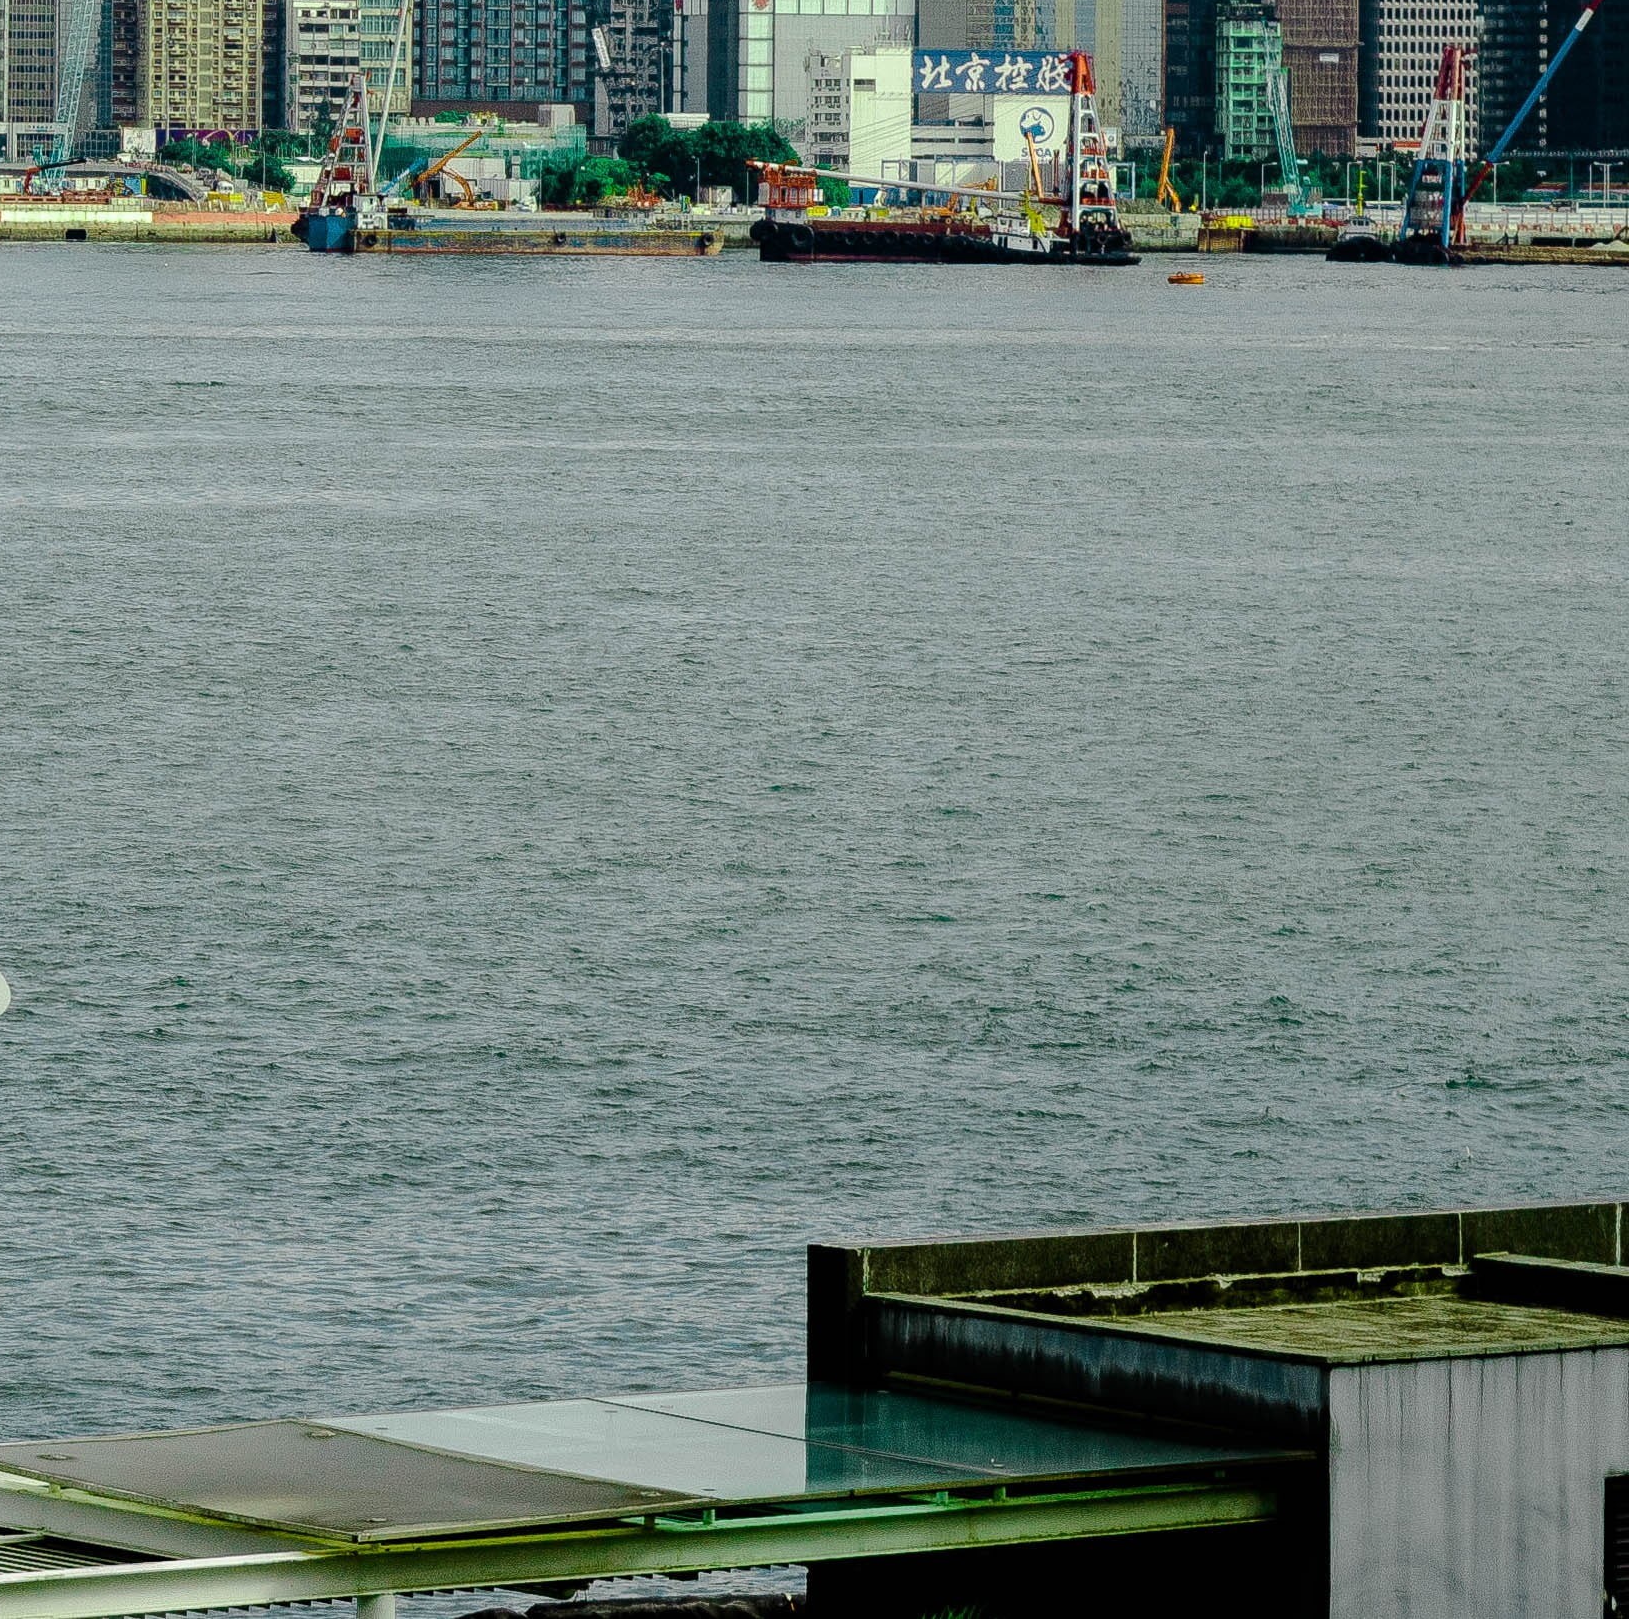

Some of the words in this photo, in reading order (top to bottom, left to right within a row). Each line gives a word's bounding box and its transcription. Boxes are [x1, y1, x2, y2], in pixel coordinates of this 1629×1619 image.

[919, 51, 1073, 92] 北京控股
[1021, 146, 1052, 158] SCA
